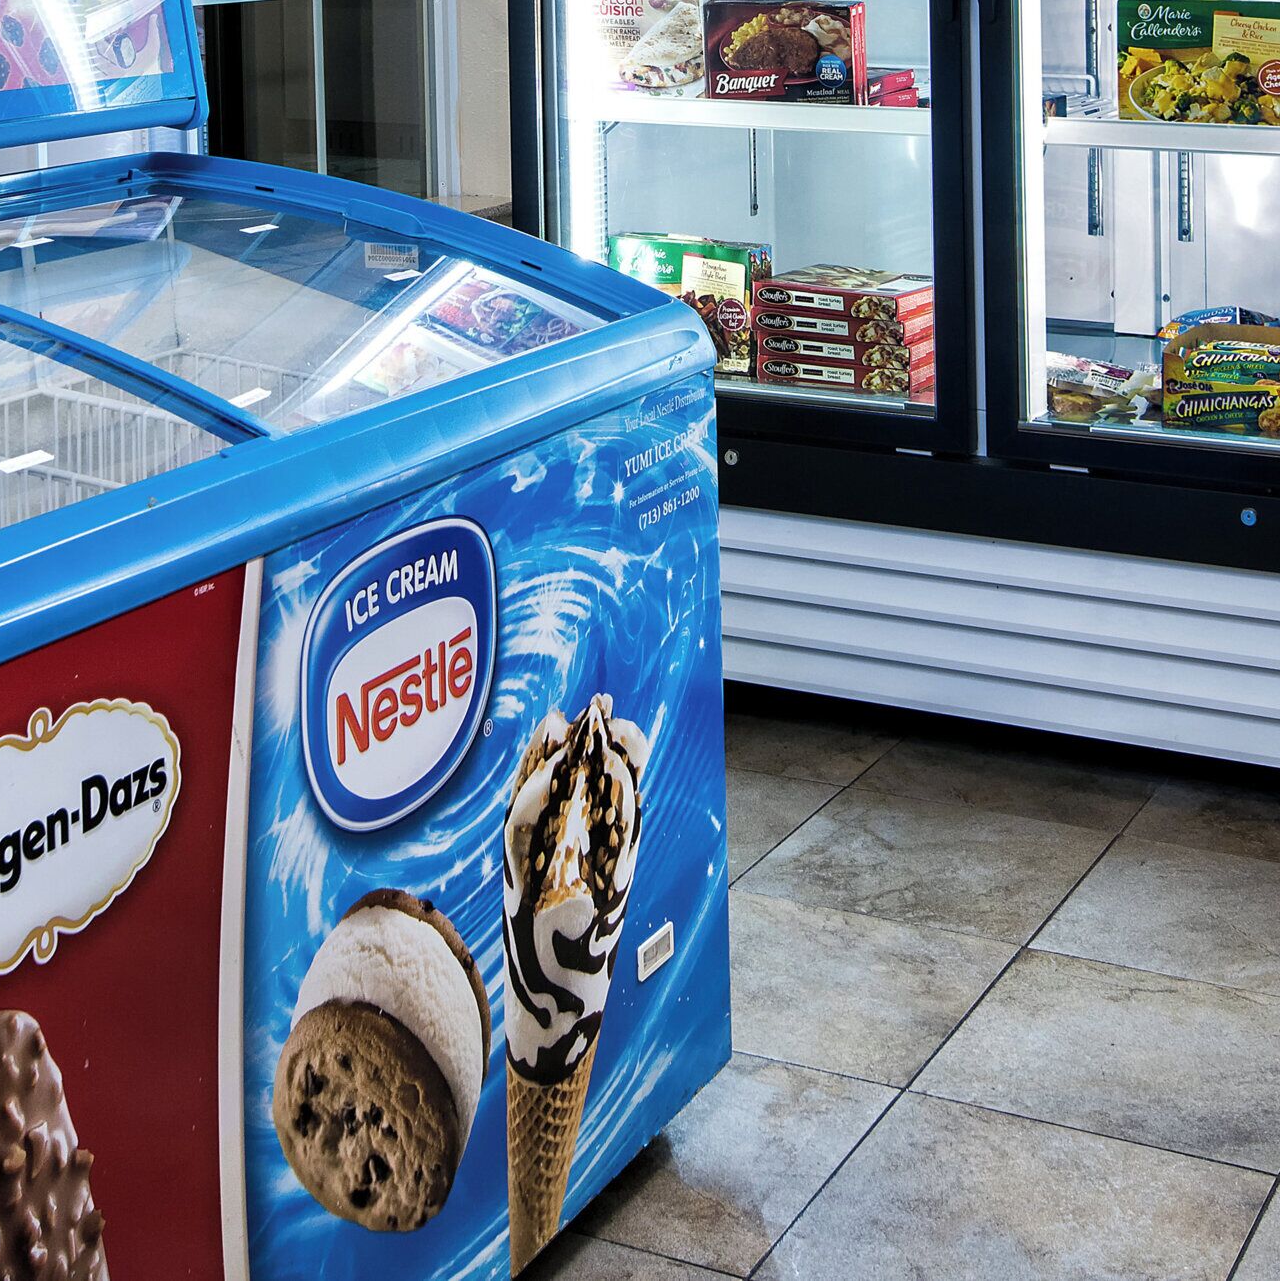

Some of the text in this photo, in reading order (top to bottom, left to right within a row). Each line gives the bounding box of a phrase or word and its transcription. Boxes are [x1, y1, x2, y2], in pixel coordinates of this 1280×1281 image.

[1146, 6, 1191, 25] Marie
[1230, 19, 1277, 32] Cheesy Chicken
[1127, 21, 1202, 40] Callender's
[820, 73, 844, 81] CREAM
[821, 67, 842, 75] REAL
[716, 73, 779, 94] Banquet
[1178, 380, 1214, 392] José Olé
[624, 416, 638, 432] Your
[640, 407, 655, 426] Local
[656, 399, 674, 420] Nestlé
[1176, 395, 1274, 418] CHIMICHANGAS
[624, 424, 709, 478] YUMI ICE CREAM
[638, 485, 700, 531] (713) 861-1200
[346, 549, 458, 633] ICE CREAM
[337, 626, 472, 766] Nestlé
